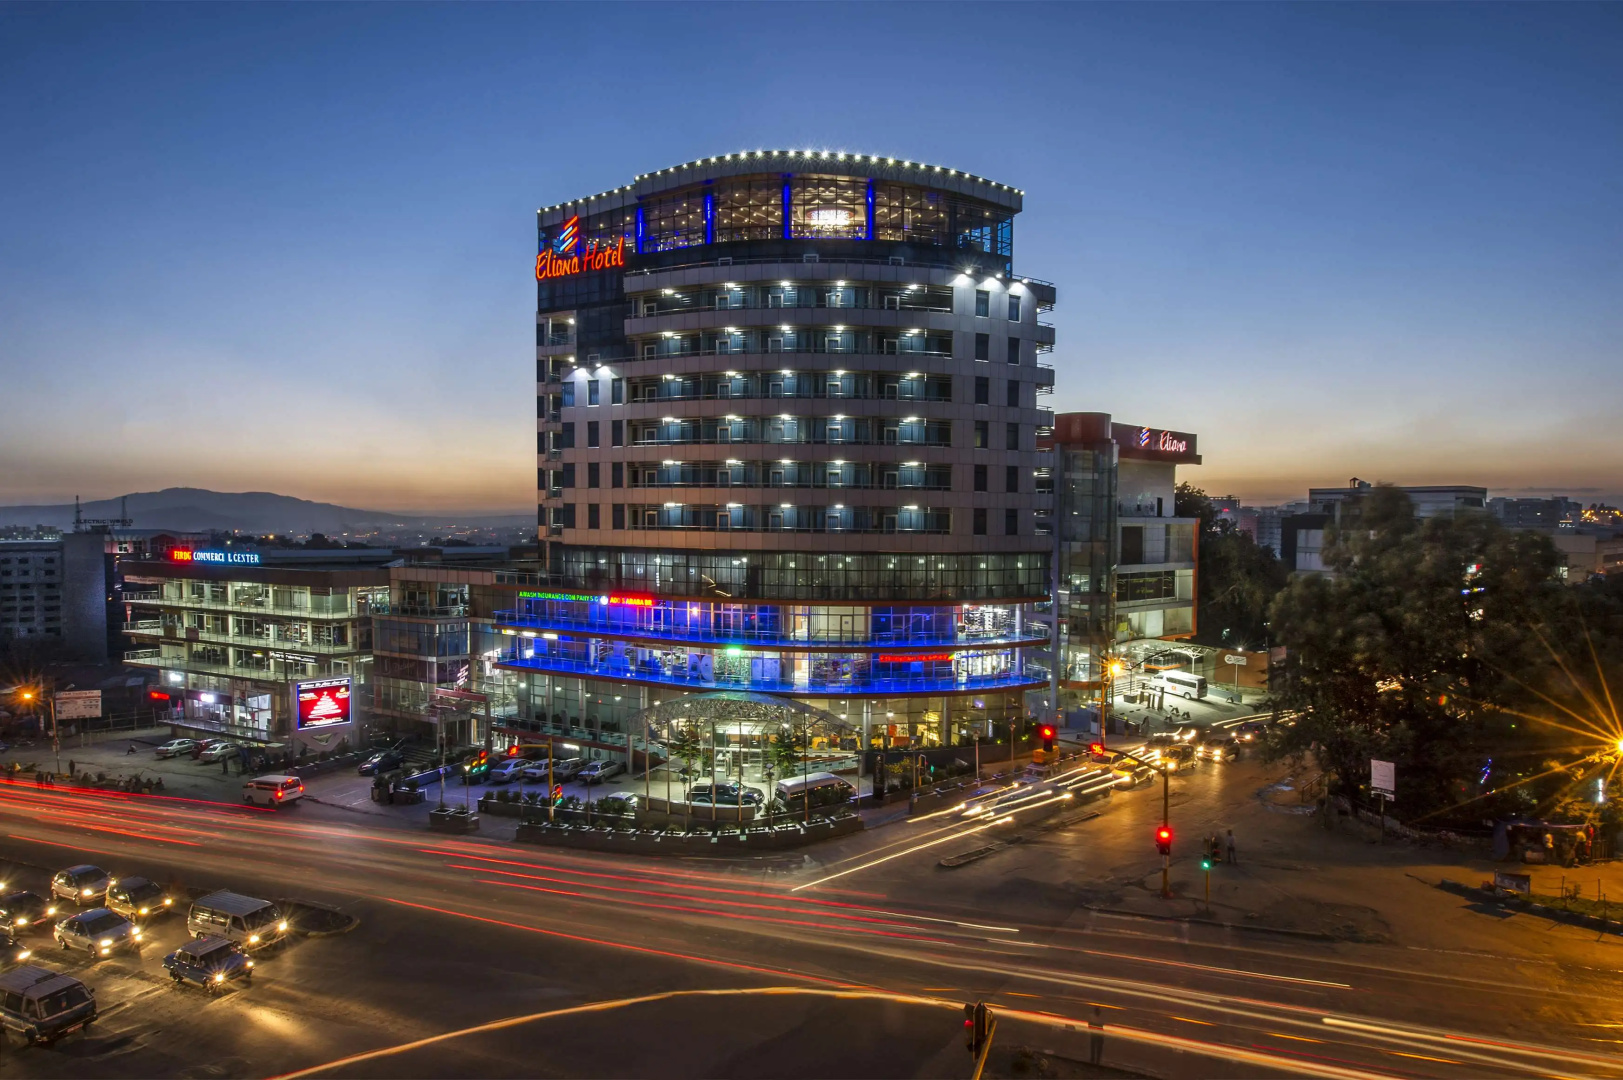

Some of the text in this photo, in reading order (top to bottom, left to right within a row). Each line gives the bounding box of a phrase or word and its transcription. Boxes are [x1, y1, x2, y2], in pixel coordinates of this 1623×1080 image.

[536, 237, 624, 280] Eliana Hotel
[1159, 430, 1187, 452] Eliana
[518, 591, 537, 599] AWASH
